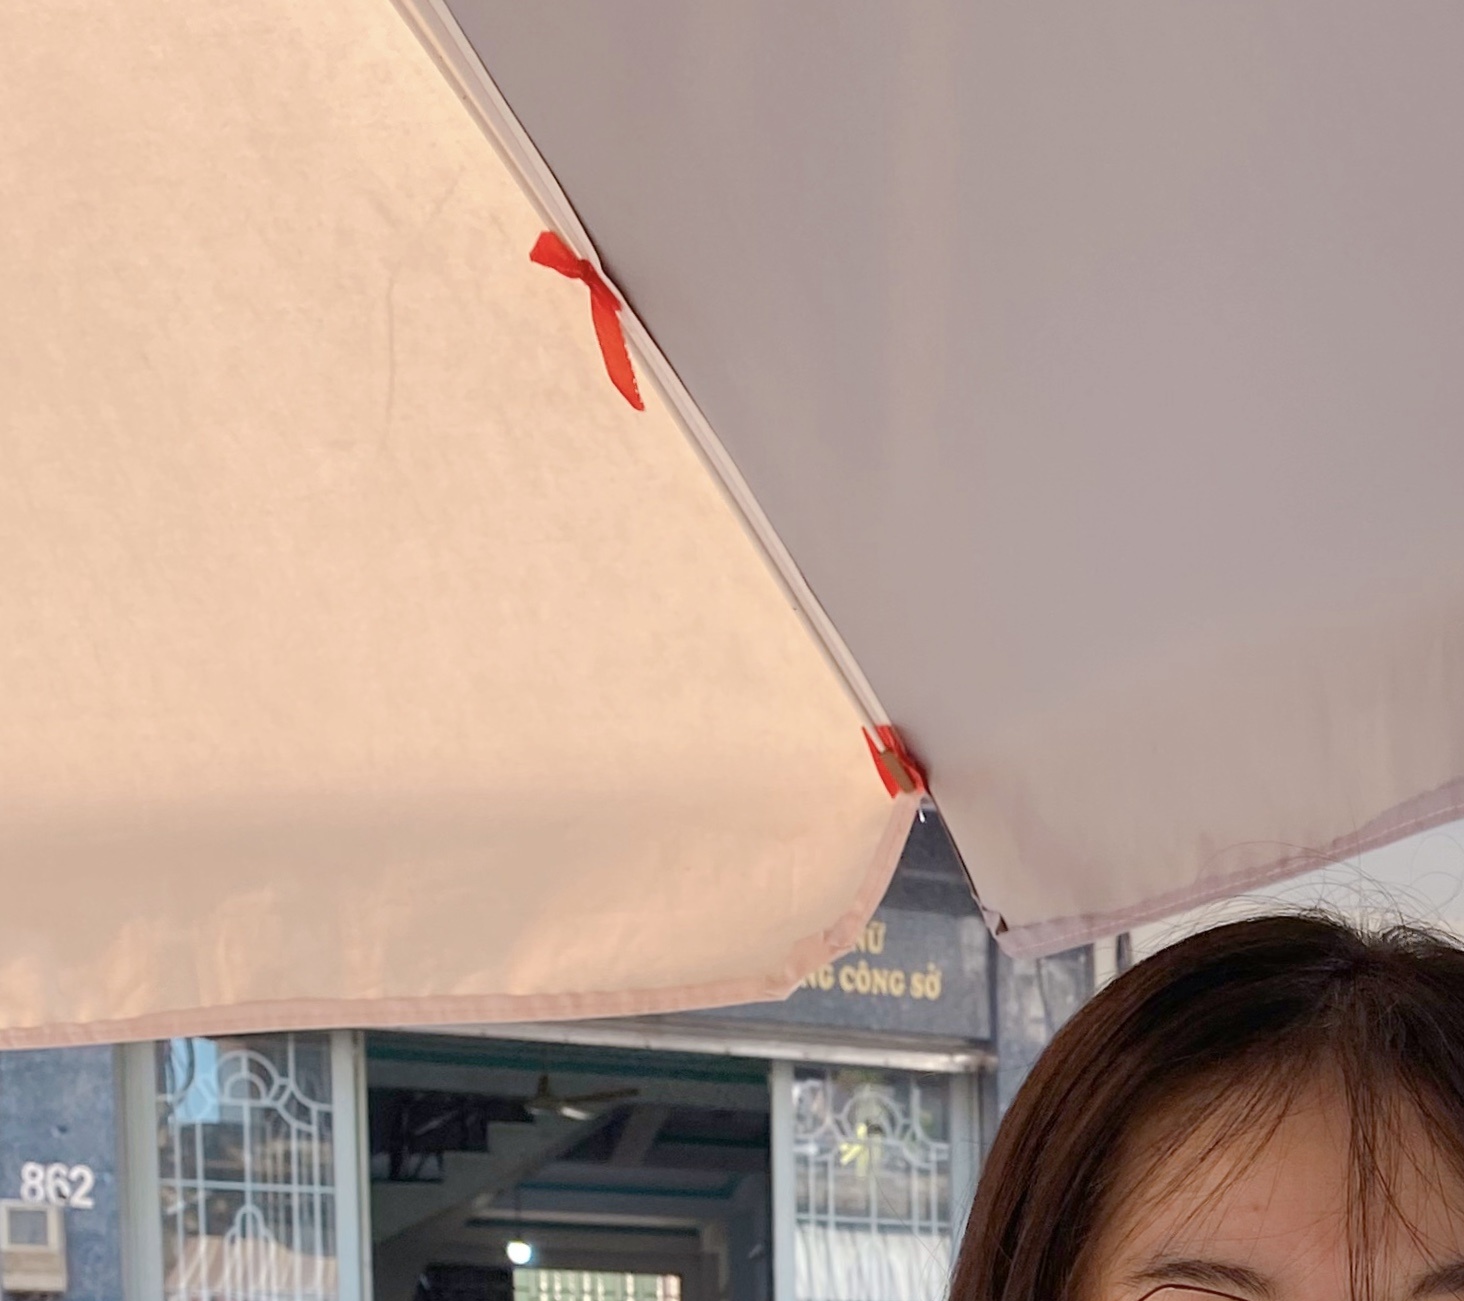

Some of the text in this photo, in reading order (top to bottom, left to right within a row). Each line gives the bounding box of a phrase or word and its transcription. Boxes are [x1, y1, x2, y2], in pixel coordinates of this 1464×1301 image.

[838, 959, 906, 997] CÔNG
[909, 962, 943, 1000] SỞ
[21, 1161, 95, 1209] 862
